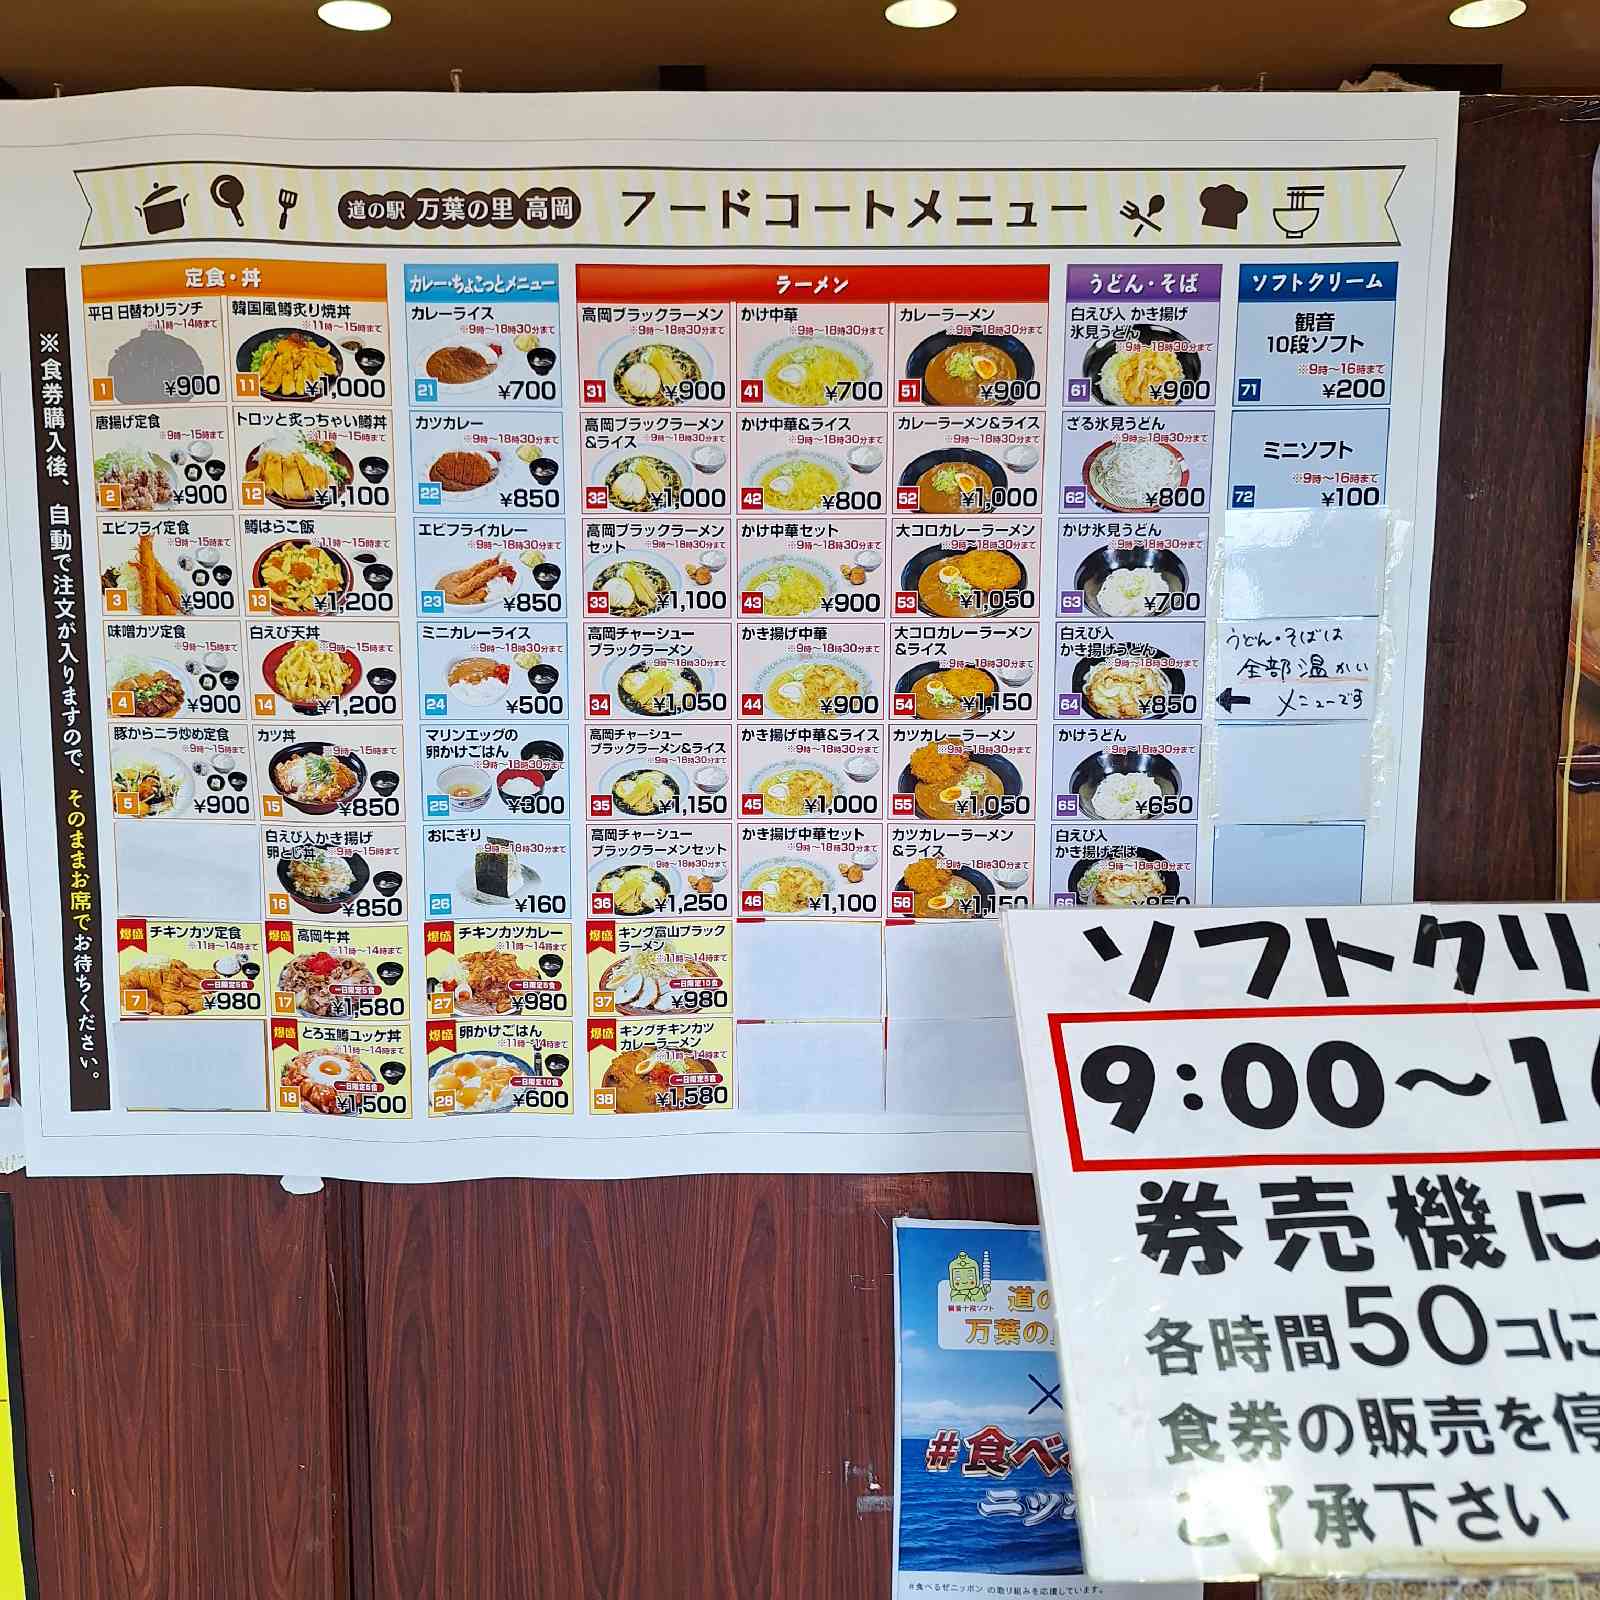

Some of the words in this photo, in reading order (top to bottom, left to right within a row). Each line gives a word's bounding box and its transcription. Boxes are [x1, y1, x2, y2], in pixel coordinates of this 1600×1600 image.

[347, 200, 406, 218] 道の駅
[416, 196, 515, 222] 万葉の里
[526, 195, 574, 220] 高岡
[622, 186, 1088, 231] フードコートメニュー
[185, 268, 261, 288] 定食・丼
[776, 276, 849, 294] ラーメン
[1089, 273, 1200, 294] うどん・そば
[1252, 275, 1384, 292] ソフトクリーム
[88, 306, 113, 320] 平日
[118, 302, 203, 319] 日替わりランチ
[411, 307, 494, 321] カレーライス
[582, 307, 724, 322] 高岡ブラックラーメン
[741, 308, 799, 321] かけ中華
[900, 309, 995, 321] カレーラーメン
[1131, 307, 1188, 321] かき揚げ
[1070, 324, 1140, 339] 氷見うどん
[1295, 313, 1335, 333] 観音
[1267, 335, 1365, 354] 10段ソフト
[100, 384, 106, 394] 1
[165, 375, 221, 396] ¥900
[306, 377, 385, 399] ¥1,000
[417, 385, 434, 397] 21
[499, 380, 556, 400] ¥700
[665, 380, 726, 400] ¥900
[825, 381, 883, 401] ¥700
[980, 381, 1041, 401] ¥900
[1071, 385, 1087, 396] 61
[1150, 381, 1210, 400] ¥900
[1241, 384, 1257, 396] 71
[1322, 379, 1386, 399] ¥200
[96, 414, 160, 430] 唐揚げ定食
[415, 416, 484, 430] カツカレー
[585, 417, 724, 432] 高岡ブラックラーメン
[741, 417, 851, 431] かけ中華&ライス
[898, 416, 1040, 430] カレーラーメン&ライス
[1067, 417, 1165, 431] ざる氷見うどん
[585, 435, 637, 449] &ライス
[1263, 441, 1354, 460] ミニソフト
[174, 484, 227, 504] ¥900
[315, 485, 389, 507] ¥1,100
[500, 489, 560, 508] ¥850
[650, 488, 726, 511] ¥1,000
[822, 492, 881, 511] ¥800
[960, 488, 1038, 511] ¥1,000
[1146, 488, 1205, 507] ¥800
[1235, 491, 1254, 503] 72
[1321, 487, 1380, 506] ¥100
[102, 520, 190, 535] エビフライ定食
[419, 524, 528, 537] エビフライカレー
[586, 524, 725, 538] 高岡ブラックラーメン
[741, 524, 838, 538] かけ中華セット
[896, 524, 1036, 538] 大コロカレーラーメン
[1062, 523, 1161, 537] かけ氷見うどん
[589, 541, 626, 554] セット
[181, 591, 234, 610] ¥900
[314, 592, 393, 613] ¥1,200
[503, 593, 561, 612] ¥850
[657, 590, 726, 613] ¥1,100
[821, 593, 880, 613] ¥900
[960, 590, 1035, 611] ¥1,050
[1144, 593, 1200, 613] ¥700
[250, 626, 320, 640] 白えび天丼
[422, 626, 530, 640] ミニカレーライス
[588, 626, 695, 640] 高岡チャーシュー
[742, 627, 827, 640] かき揚げ中華
[895, 627, 1032, 640] 大コロカレーラーメン
[590, 643, 693, 656] ブラックラーメン
[895, 643, 947, 656] &ライス
[1060, 642, 1157, 657] かき揚げうどん
[188, 695, 241, 713] ¥900
[318, 696, 396, 717] ¥1,200
[506, 695, 564, 715] ¥500
[653, 692, 727, 713] ¥1,050
[820, 695, 879, 714] ¥900
[963, 693, 1032, 713] ¥1,150
[1138, 695, 1196, 714] ¥850
[258, 730, 296, 742] カツ丼
[425, 729, 518, 742] マリンエッグの
[590, 729, 682, 741] 高岡チャーシュー
[741, 728, 880, 742] かき揚げ中華&ライス
[893, 729, 1016, 741] カツカレーラーメン
[1058, 728, 1126, 742] かけうどん
[426, 745, 509, 759] 卵かけごはん
[591, 743, 726, 754] ブラックラーメン&ライス
[194, 796, 249, 814] ¥900
[336, 798, 399, 817] ¥850
[508, 795, 565, 814] ¥300
[659, 795, 728, 816] ¥1,150
[804, 795, 877, 815] ¥1,000
[956, 795, 1030, 815] ¥1,050
[1136, 796, 1193, 814] ¥650
[427, 828, 481, 842] おにぎり
[591, 829, 693, 841] 高岡チャーシュー
[742, 828, 864, 841] かき揚げ中華セット
[893, 829, 1014, 841] カツカレーラーメン
[267, 846, 317, 860] 卵とじ丼
[593, 844, 727, 856] ブラックラーメンセット
[893, 845, 945, 857] &ライス
[342, 899, 402, 917] ¥850
[515, 895, 566, 914] ¥160
[654, 893, 728, 915] ¥1,250
[809, 894, 877, 914] ¥1,100
[150, 926, 242, 940] チキンカツ定食
[298, 930, 350, 943] 高岡牛丼
[459, 926, 563, 939] チキンカツカレー
[619, 925, 726, 938] キング富山ブラック
[620, 941, 664, 952] ラーメン
[1083, 912, 1600, 1004] ソフトクリ
[203, 992, 260, 1010] ¥980
[332, 998, 404, 1018] ¥1,580
[512, 992, 567, 1011] ¥980
[671, 991, 728, 1009] ¥980
[459, 1025, 542, 1038] 卵かけごはん
[620, 1023, 714, 1035] キングチキンカツ
[620, 1037, 701, 1050] カレーラーメン
[1080, 1035, 1600, 1134] 9:00〜1
[337, 1096, 406, 1115] ¥1,500
[513, 1091, 568, 1109] ¥600
[656, 1086, 728, 1109] ¥1,580
[1135, 1174, 1600, 1275] 券売機に
[965, 1318, 1056, 1345] 万葉の
[926, 1425, 1073, 1478] #食べ
